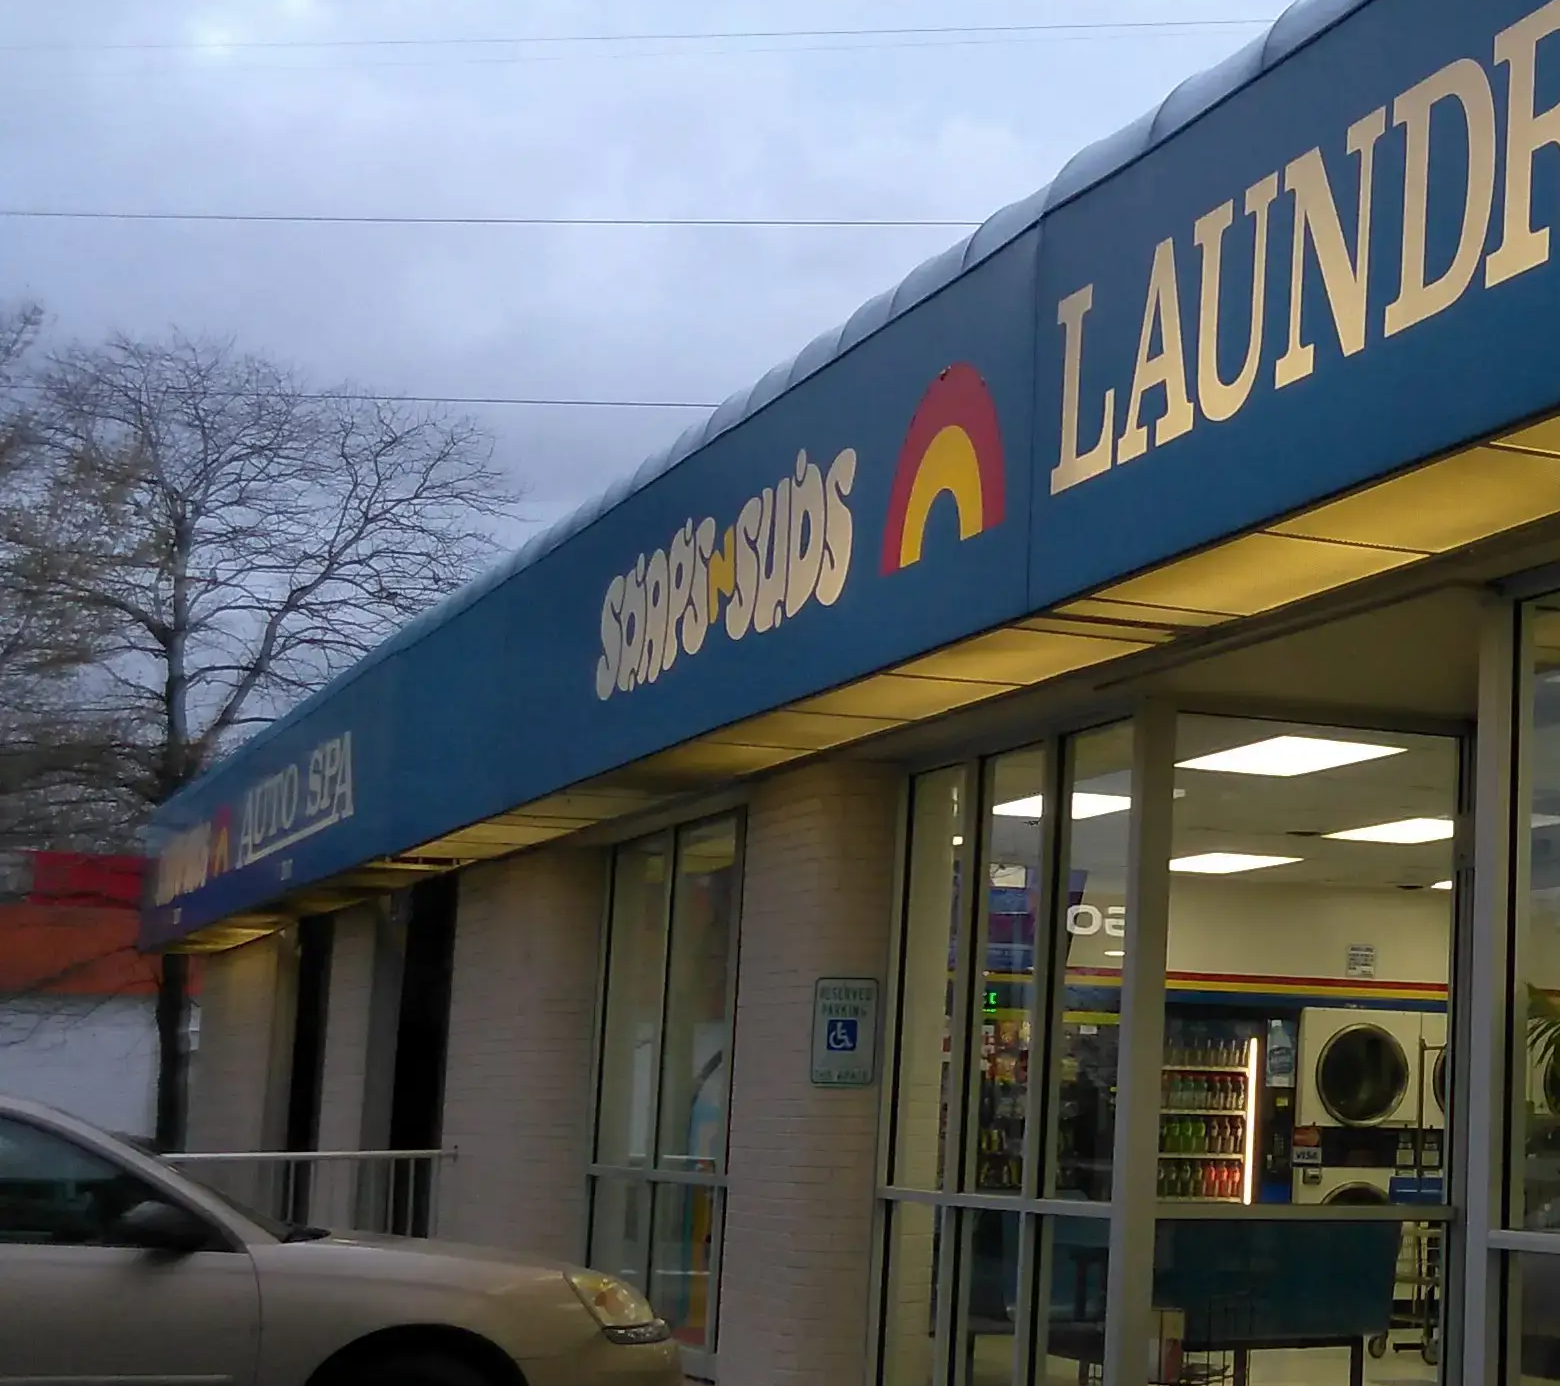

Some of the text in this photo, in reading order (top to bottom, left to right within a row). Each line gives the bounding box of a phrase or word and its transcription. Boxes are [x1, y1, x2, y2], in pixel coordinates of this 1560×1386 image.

[725, 448, 857, 641] SUDS
[235, 763, 299, 870] AUTO
[305, 730, 355, 821] SPA
[822, 1003, 868, 1018] PARKING
